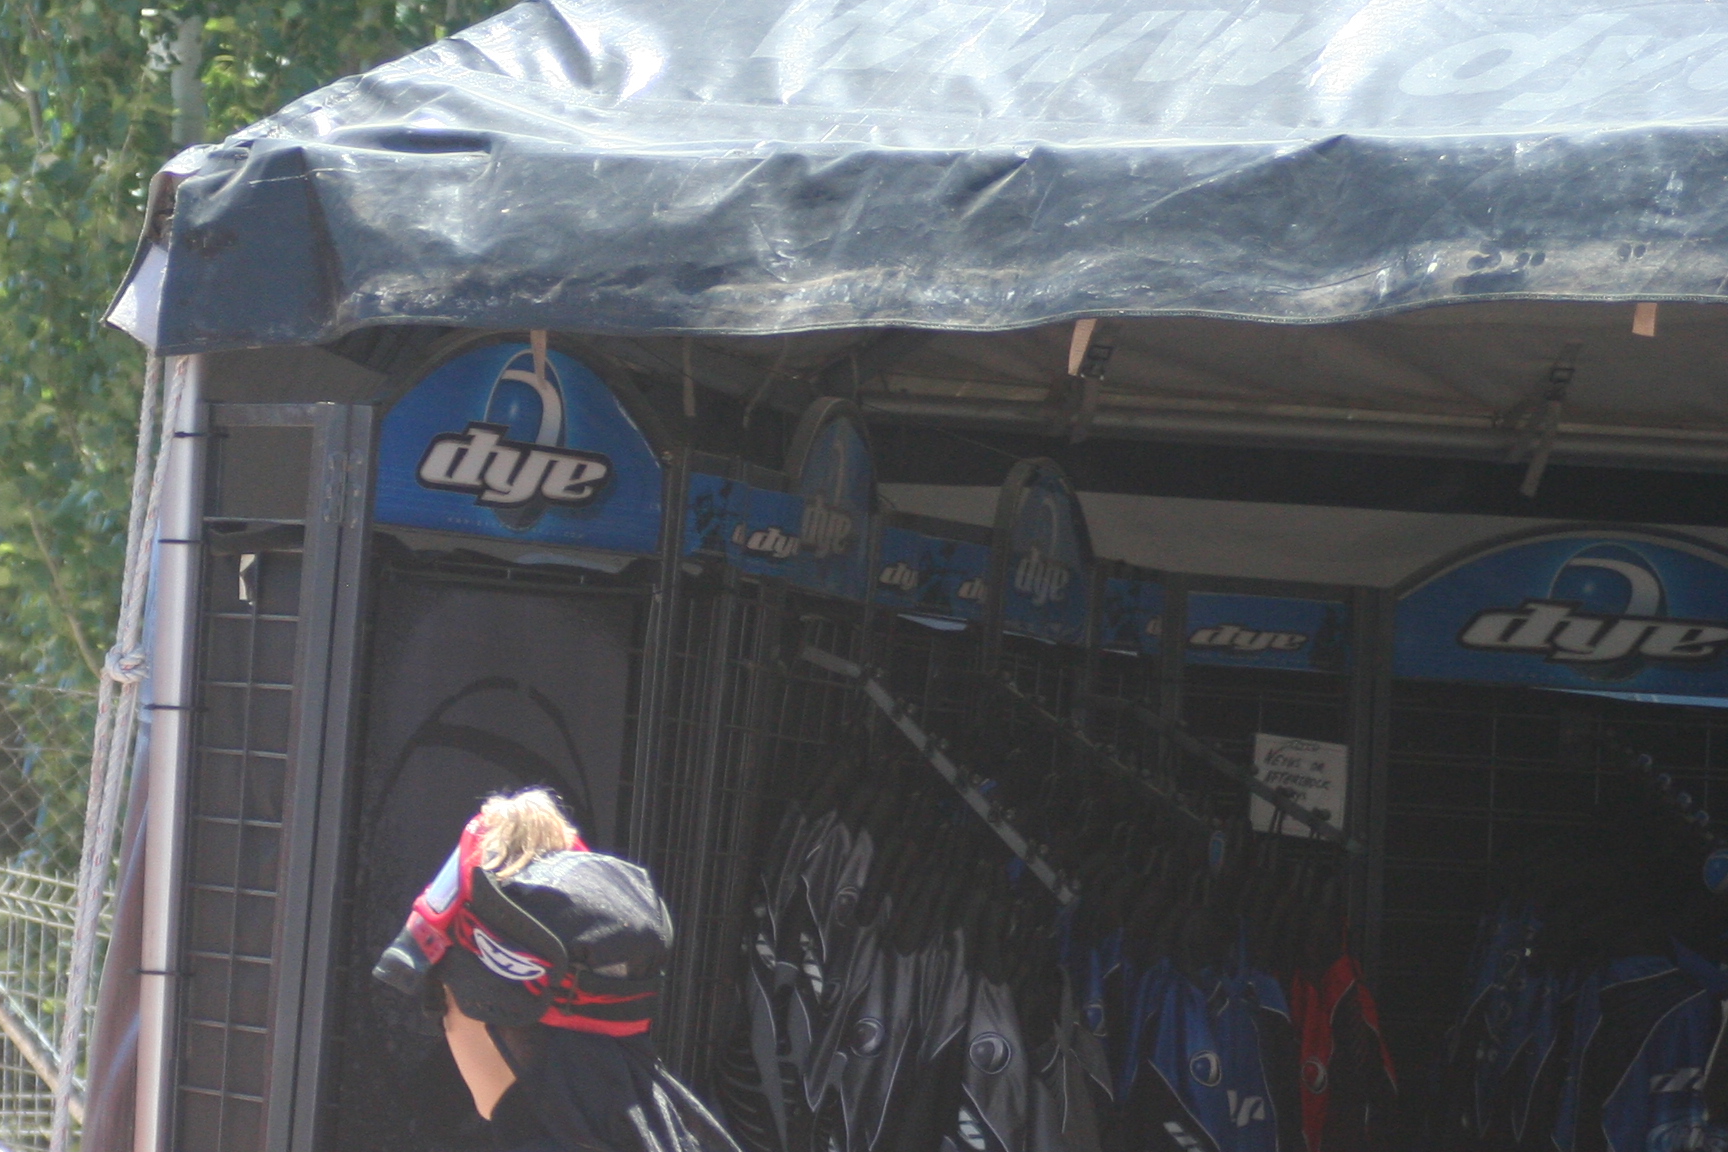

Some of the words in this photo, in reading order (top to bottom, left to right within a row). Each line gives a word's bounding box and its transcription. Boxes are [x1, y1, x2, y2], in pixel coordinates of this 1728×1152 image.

[417, 422, 611, 506] dye
[746, 527, 800, 559] dy
[1188, 623, 1309, 653] dye
[1458, 599, 1728, 664] dye
